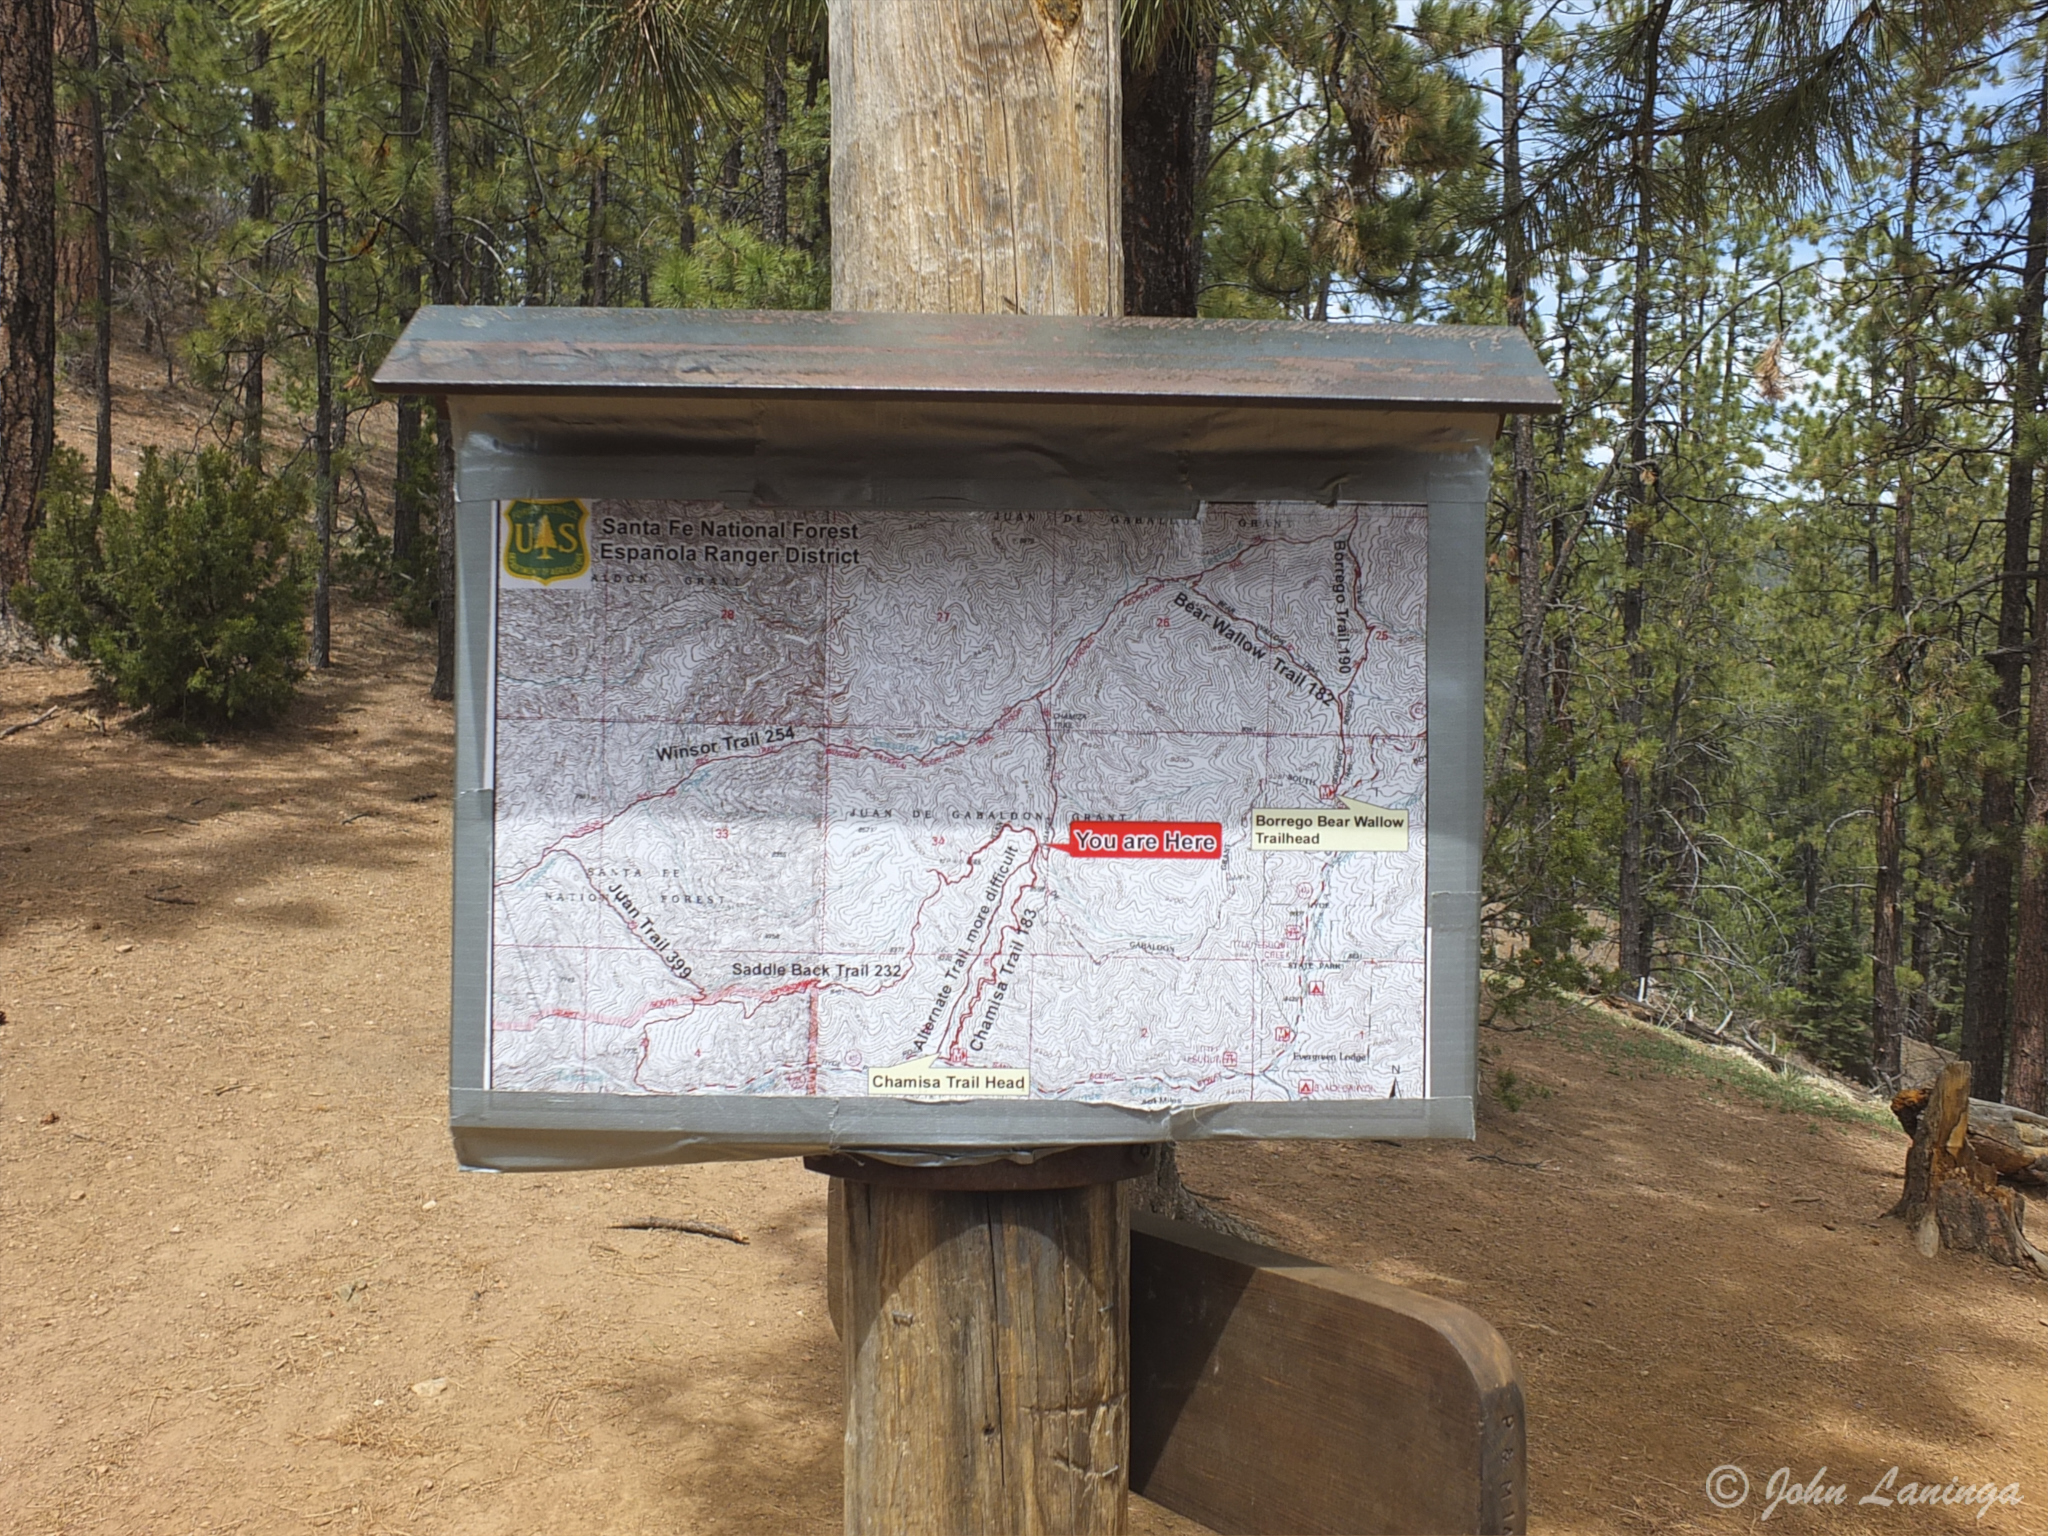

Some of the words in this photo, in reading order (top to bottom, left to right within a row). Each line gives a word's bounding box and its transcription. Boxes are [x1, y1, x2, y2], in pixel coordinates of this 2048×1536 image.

[602, 518, 661, 536] Santa
[669, 519, 694, 537] Fe
[701, 520, 785, 539] National
[793, 522, 859, 539] Forest
[600, 544, 697, 563] Española
[704, 546, 779, 566] Ranger
[785, 547, 860, 564] District
[1332, 540, 1346, 604] Borrego
[721, 609, 735, 620] 28
[937, 611, 950, 622] 27
[1156, 618, 1170, 628] 26
[1336, 609, 1350, 644] Trail
[1174, 592, 1212, 622] Bear
[1212, 616, 1266, 660] Wallow
[1272, 657, 1308, 687] Trail
[1376, 631, 1389, 641] 25
[1339, 648, 1351, 675] 190
[656, 741, 718, 762] Winsor
[722, 733, 760, 751] Trail
[764, 726, 795, 743] 254
[850, 809, 893, 818] JUAN
[912, 809, 932, 818] DE
[952, 810, 1044, 820] GABALDON
[1255, 815, 1313, 829] Borrego
[1317, 815, 1350, 828] Bear
[1354, 816, 1404, 828] Wallow
[716, 828, 729, 839] 33
[1255, 833, 1320, 845] Trailhead
[1074, 831, 1116, 851] You
[1123, 836, 1158, 850] are
[1165, 833, 1217, 851] Here
[608, 884, 640, 919] Juan
[640, 918, 671, 952] Trail
[666, 951, 692, 979] 399
[913, 986, 952, 1050] Alternate
[966, 905, 990, 943] more
[984, 845, 1018, 902] difficult
[732, 963, 786, 977] Saddle
[792, 963, 830, 977] Back
[837, 964, 869, 977] Trail
[874, 965, 901, 977] 232
[969, 982, 1008, 1051] Chamisa
[1000, 941, 1024, 979] Trail
[1017, 908, 1037, 936] 183
[1293, 1052, 1336, 1061] Evergreen
[1339, 1052, 1367, 1062] Lodge
[1392, 1065, 1400, 1074] N
[872, 1075, 940, 1089] Chamisa
[946, 1075, 979, 1089] Trail
[985, 1076, 1024, 1089] Head
